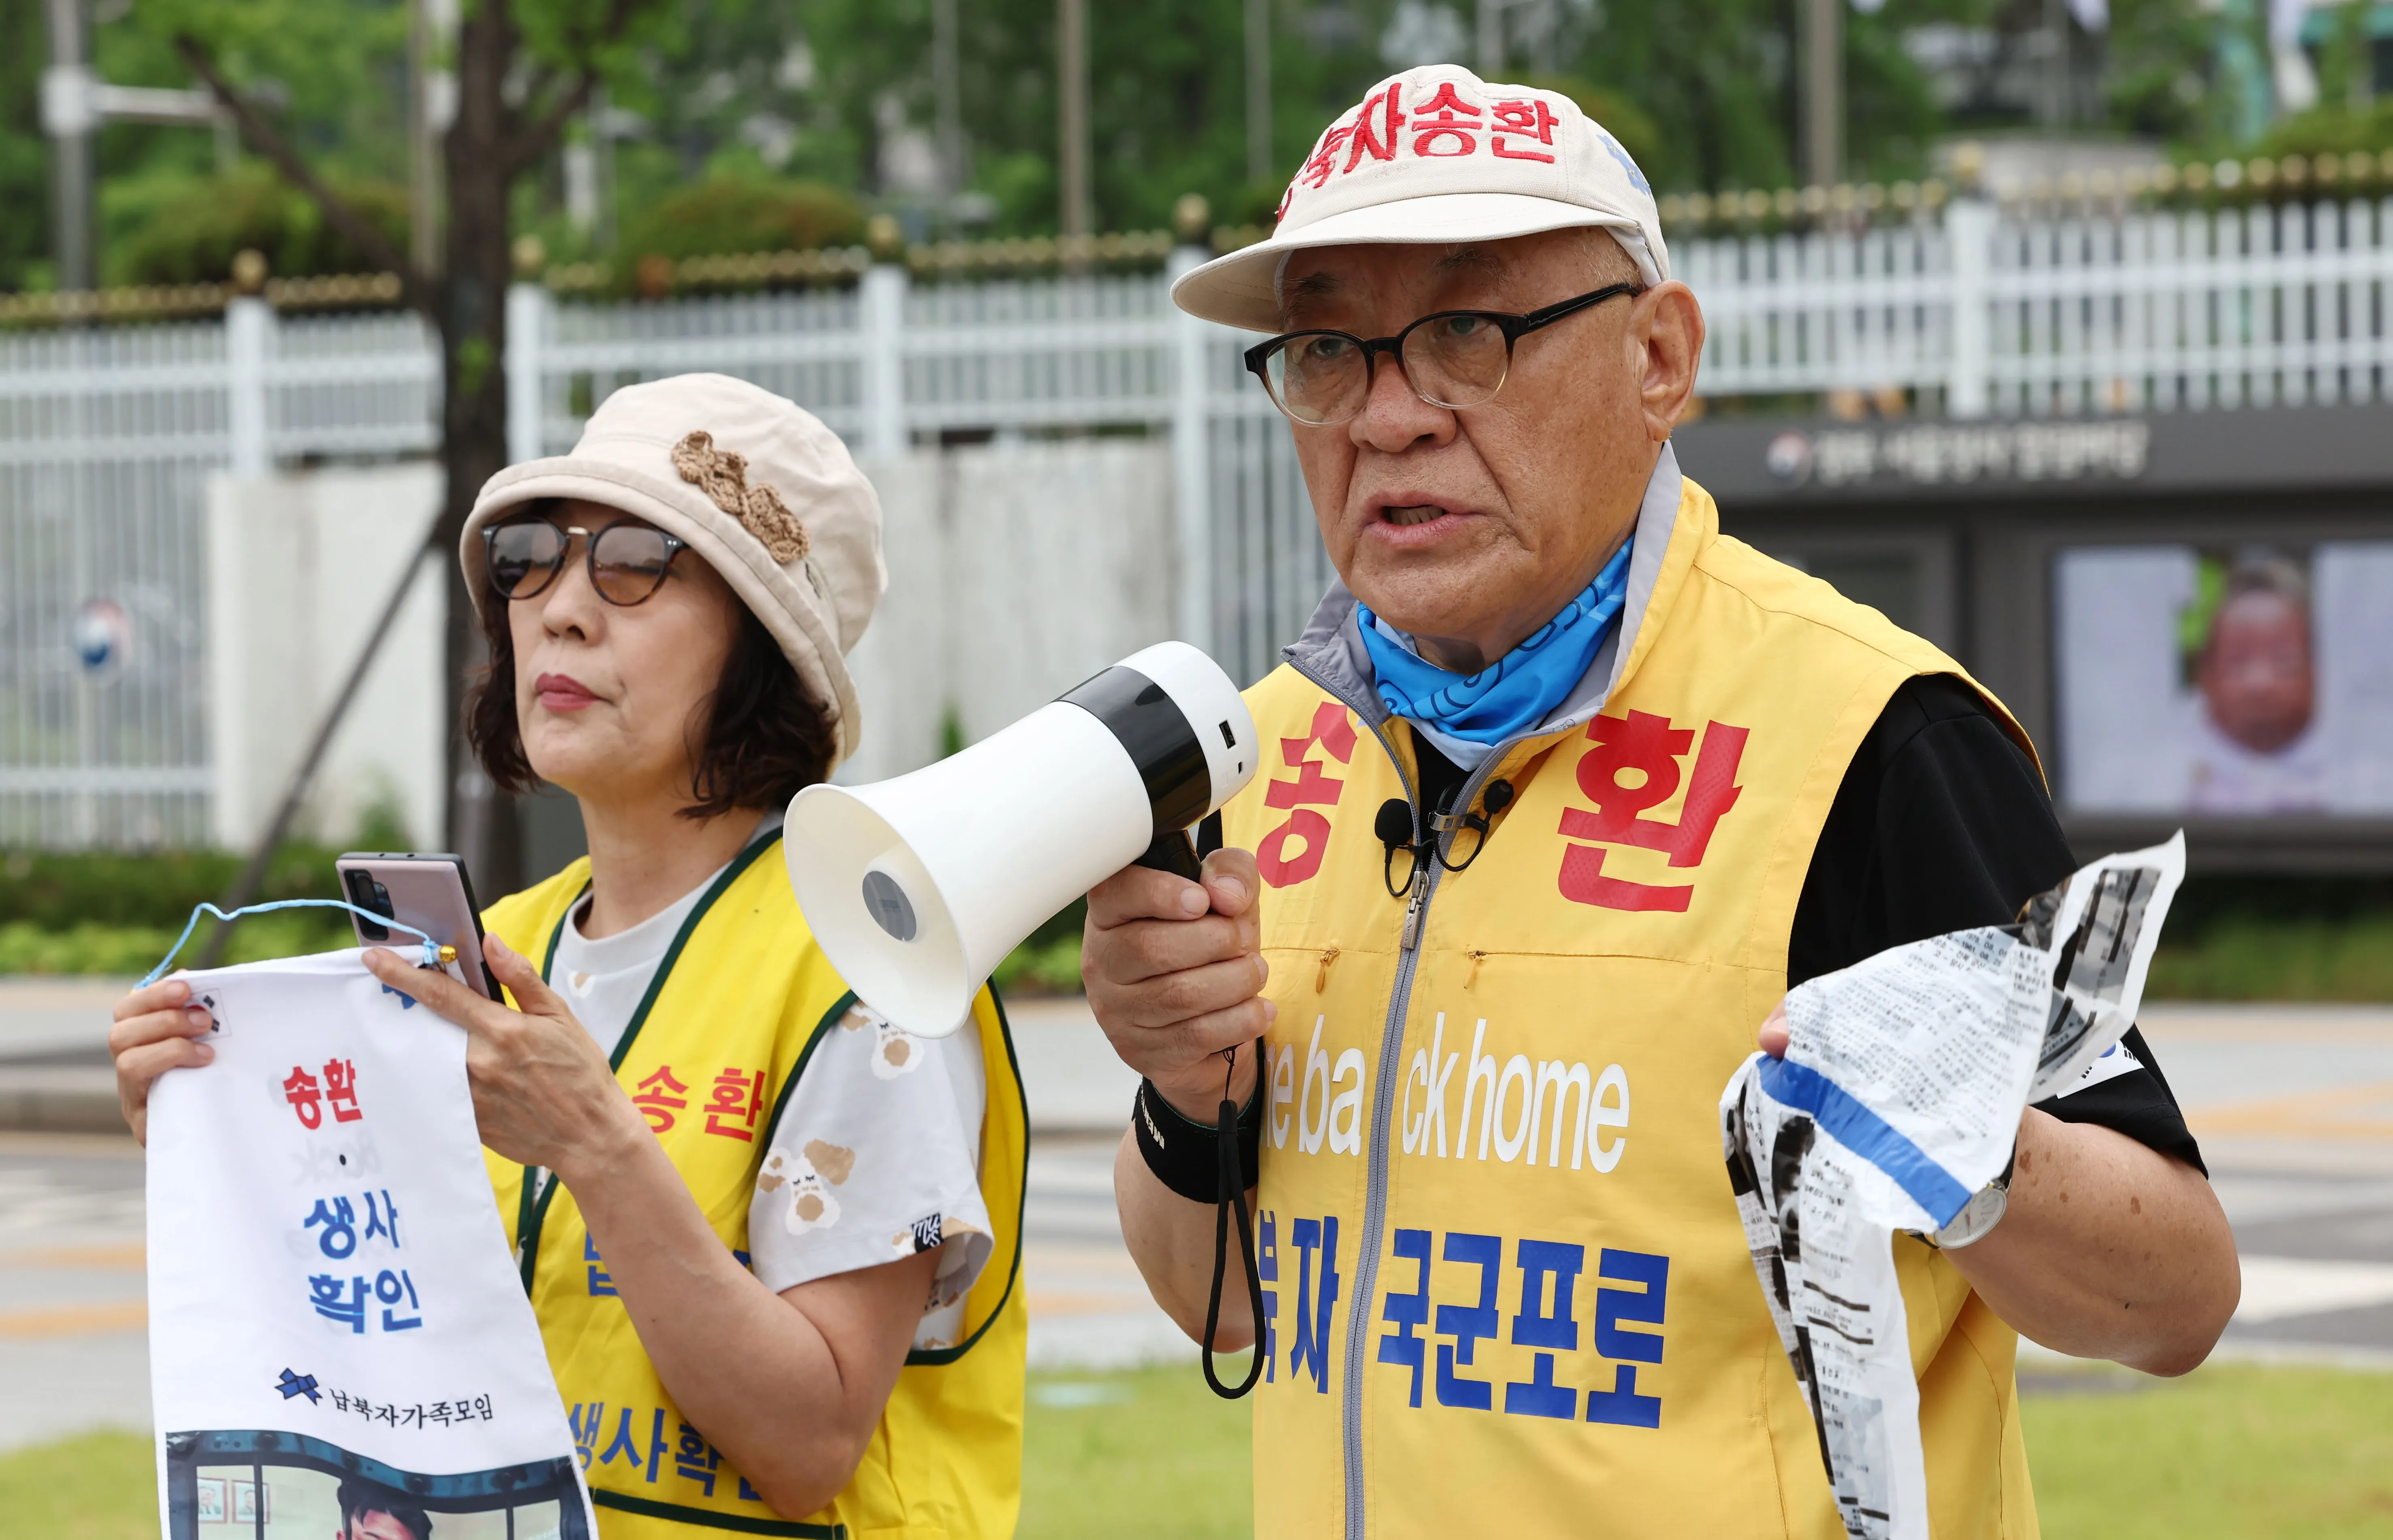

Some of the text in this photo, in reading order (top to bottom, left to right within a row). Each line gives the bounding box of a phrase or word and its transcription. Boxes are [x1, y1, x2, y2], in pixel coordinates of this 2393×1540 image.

[283, 1058, 363, 1130] 송환
[632, 1066, 765, 1143] 송환
[304, 1189, 400, 1259] 생사
[308, 1269, 422, 1334] 확인
[1378, 1228, 1669, 1429] 국군포로
[330, 1388, 494, 1429] 납북자가족모임
[569, 1401, 764, 1501] 생사확
